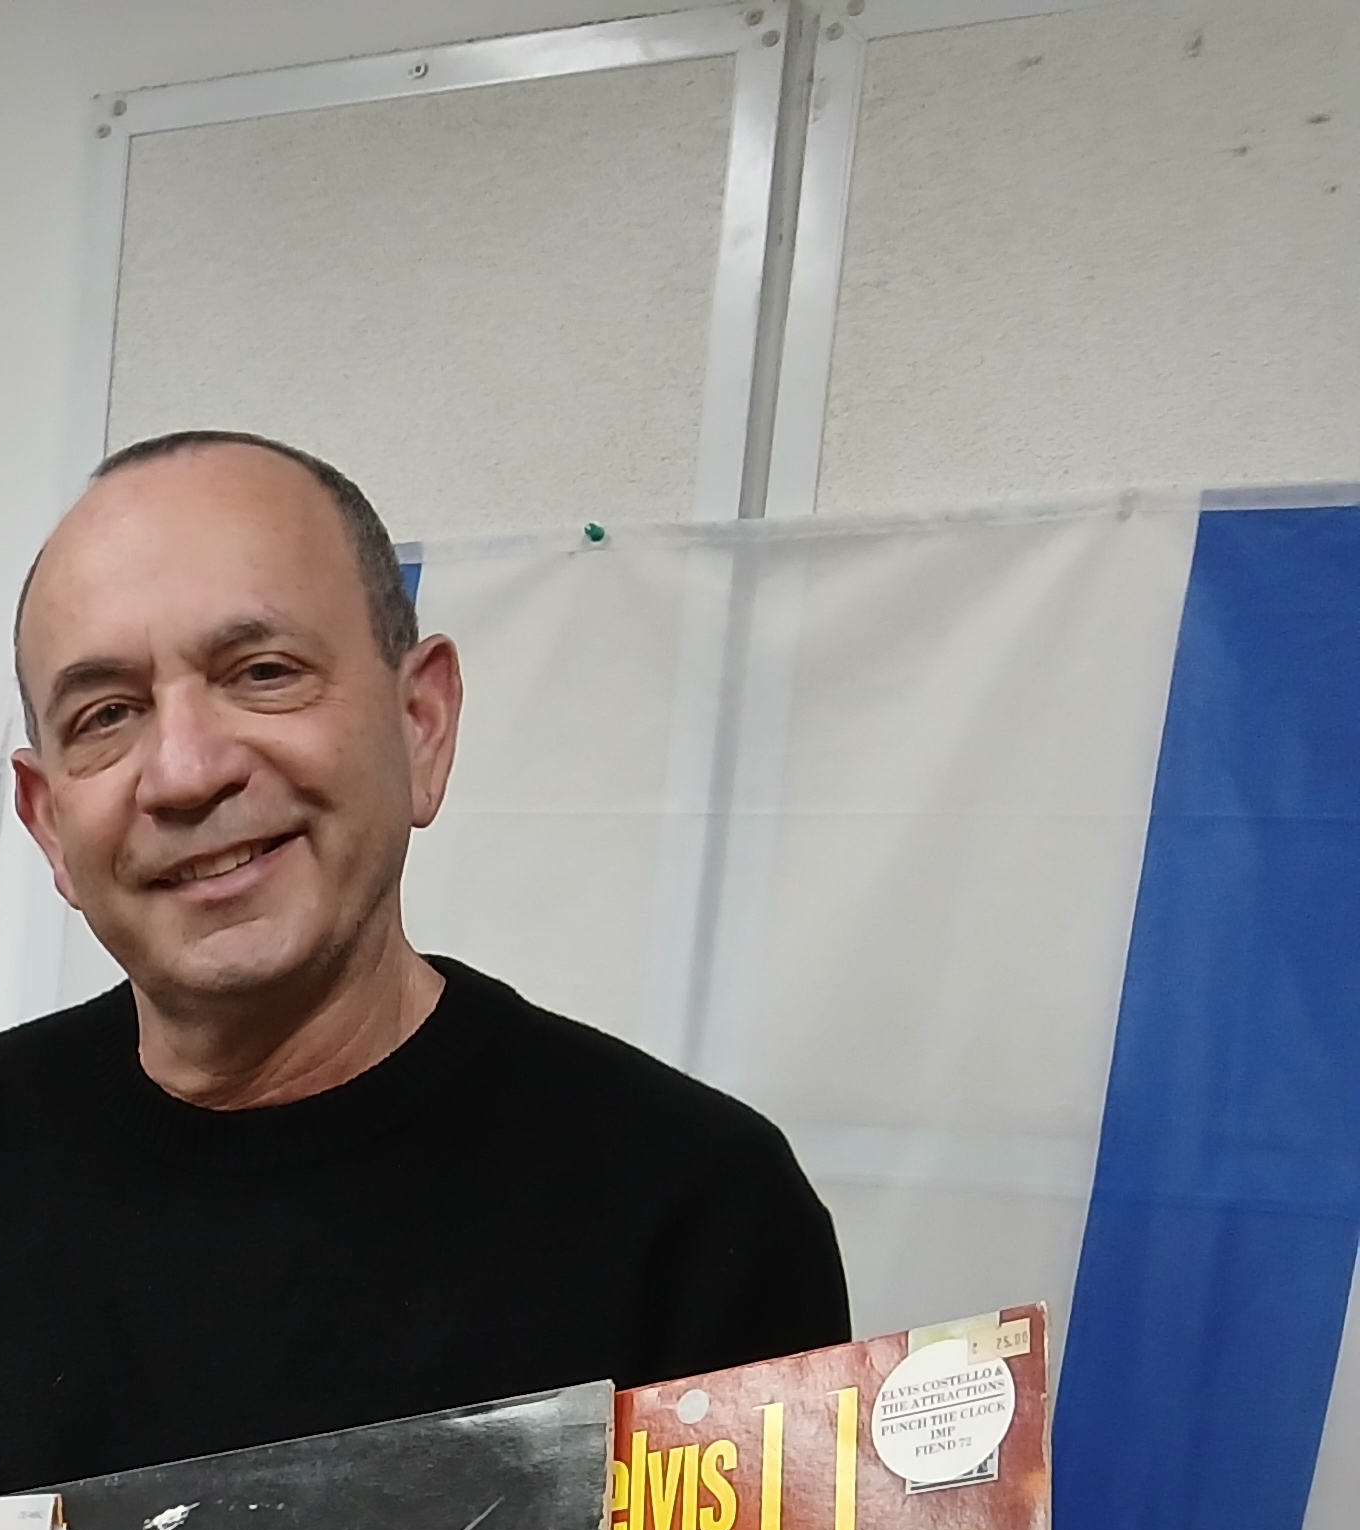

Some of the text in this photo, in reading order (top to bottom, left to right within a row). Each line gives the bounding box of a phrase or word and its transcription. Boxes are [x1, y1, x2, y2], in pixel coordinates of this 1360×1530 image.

[881, 1387, 920, 1402] ELVIS
[922, 1367, 992, 1393] COSTELLO
[881, 1380, 1005, 1416] THE ATTRACTIONS
[881, 1402, 1006, 1437] PUNCH THE CLOCK
[931, 1426, 956, 1441] IMP
[915, 1439, 956, 1457] FIEND
